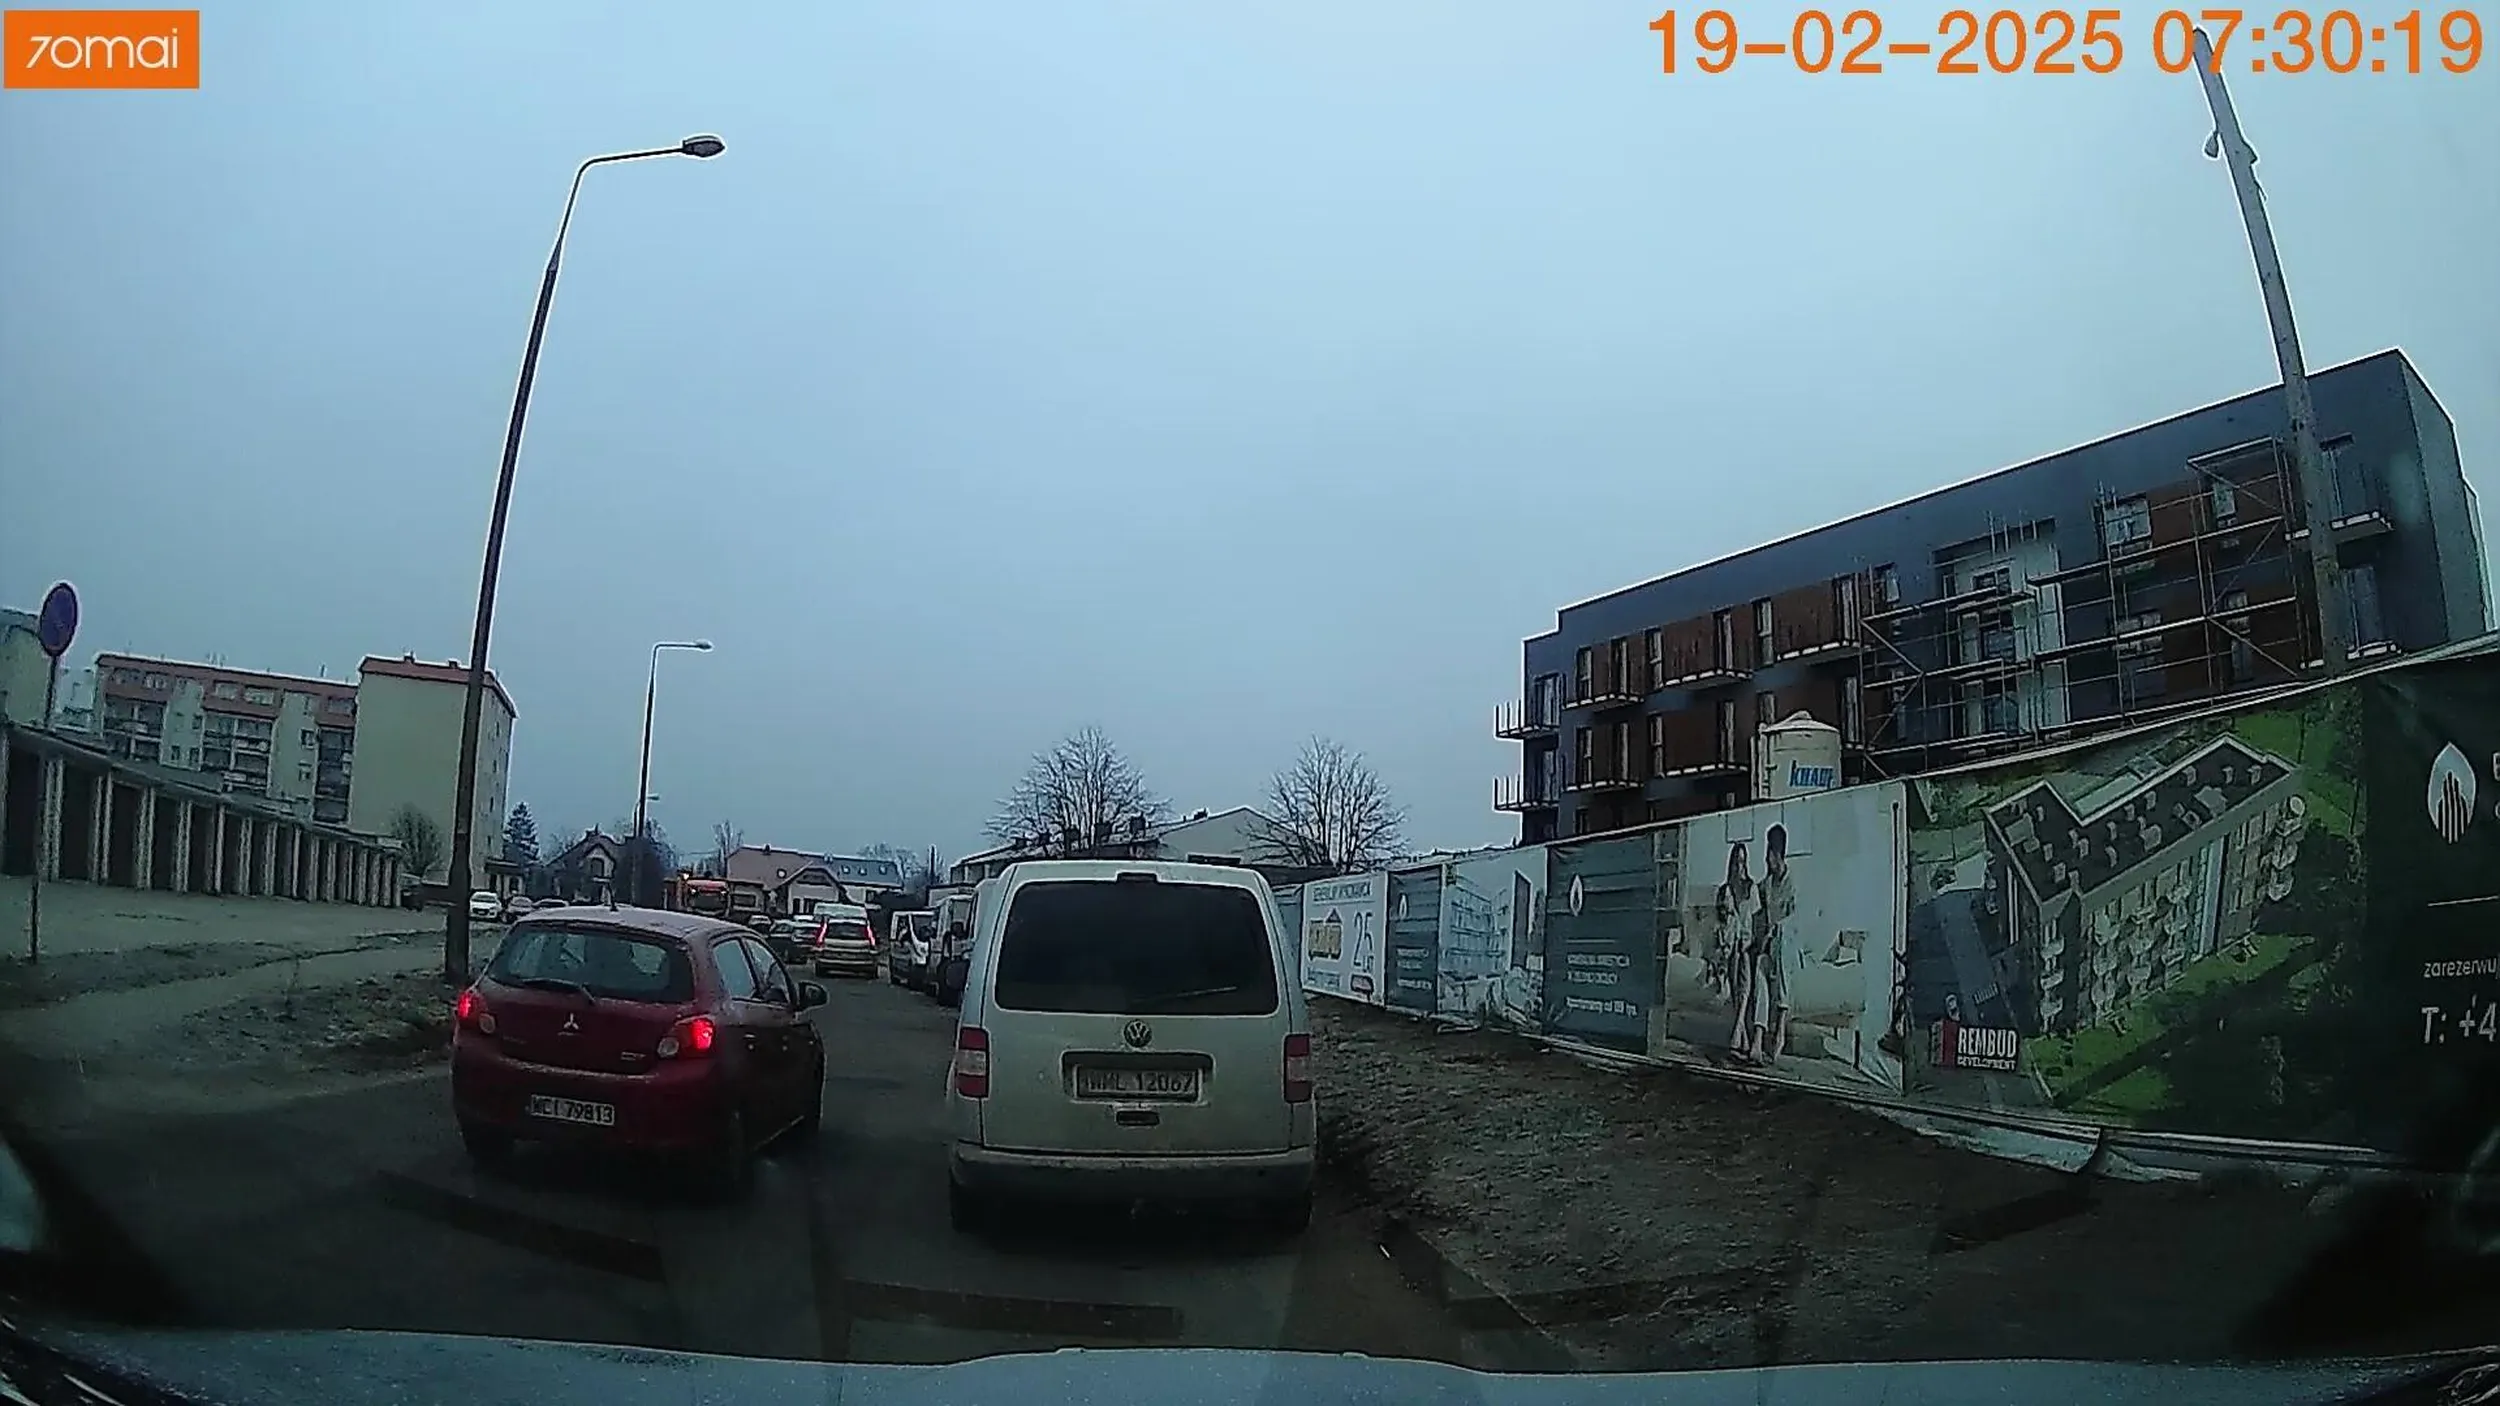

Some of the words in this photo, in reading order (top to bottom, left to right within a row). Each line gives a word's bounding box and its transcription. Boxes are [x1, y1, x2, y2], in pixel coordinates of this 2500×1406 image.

[2421, 1006, 2447, 1044] T:
[2459, 1002, 2497, 1042] +4
[1957, 1027, 2017, 1058] REMBUD
[1957, 1055, 2017, 1071] DEVELOPMENT
[565, 1100, 613, 1123] 79813
